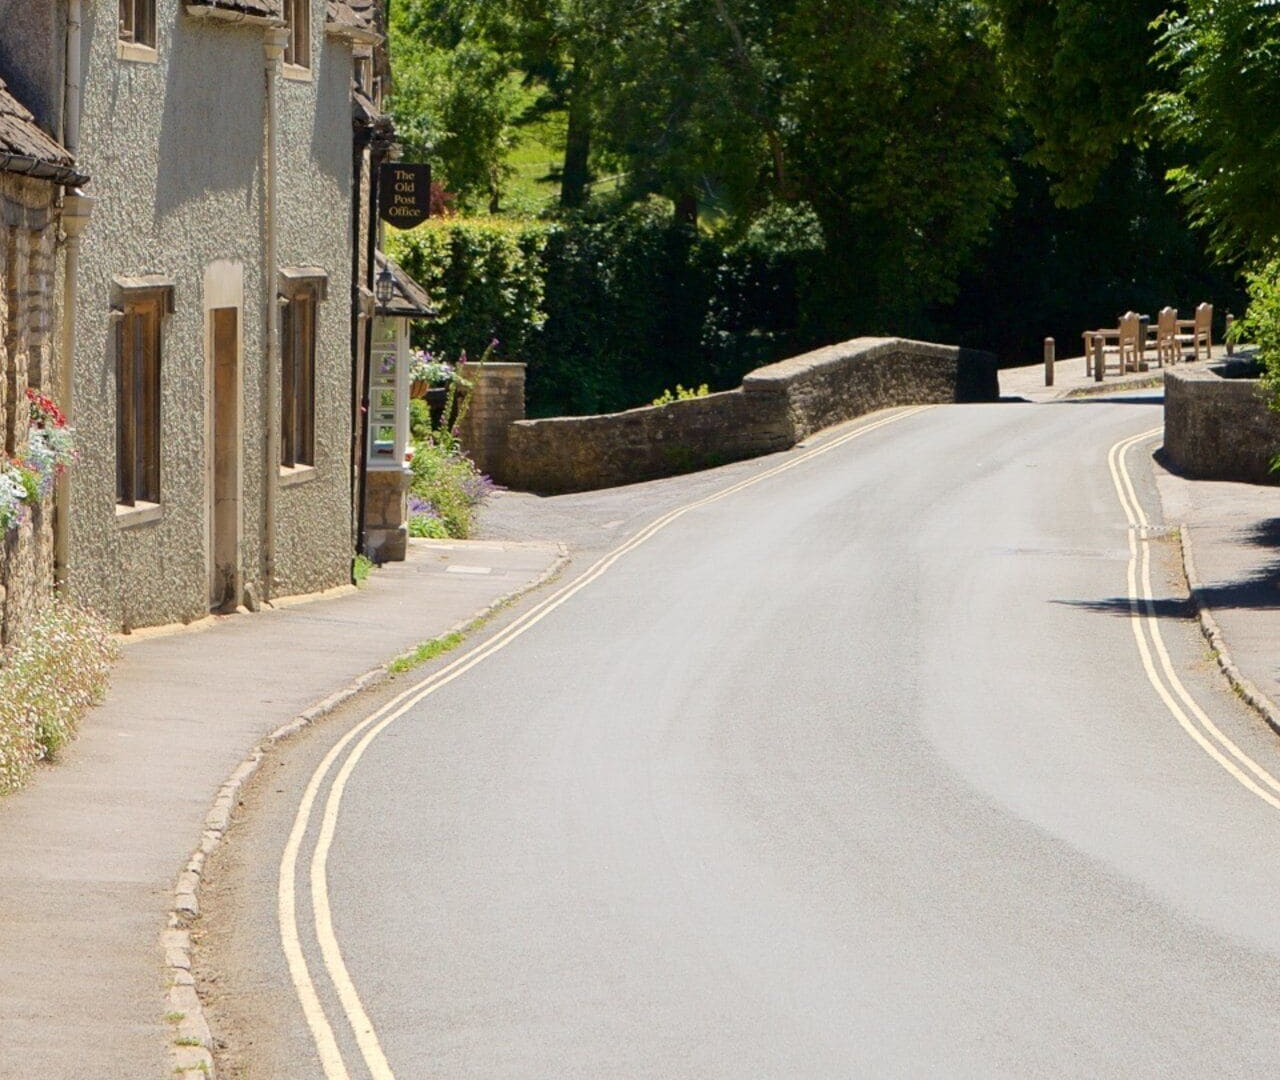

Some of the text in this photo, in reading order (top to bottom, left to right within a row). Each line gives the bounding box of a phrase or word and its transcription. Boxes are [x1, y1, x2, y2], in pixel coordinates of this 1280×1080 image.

[394, 170, 415, 180] The
[394, 182, 415, 192] Old
[394, 195, 415, 205] Post
[388, 206, 421, 216] Office
